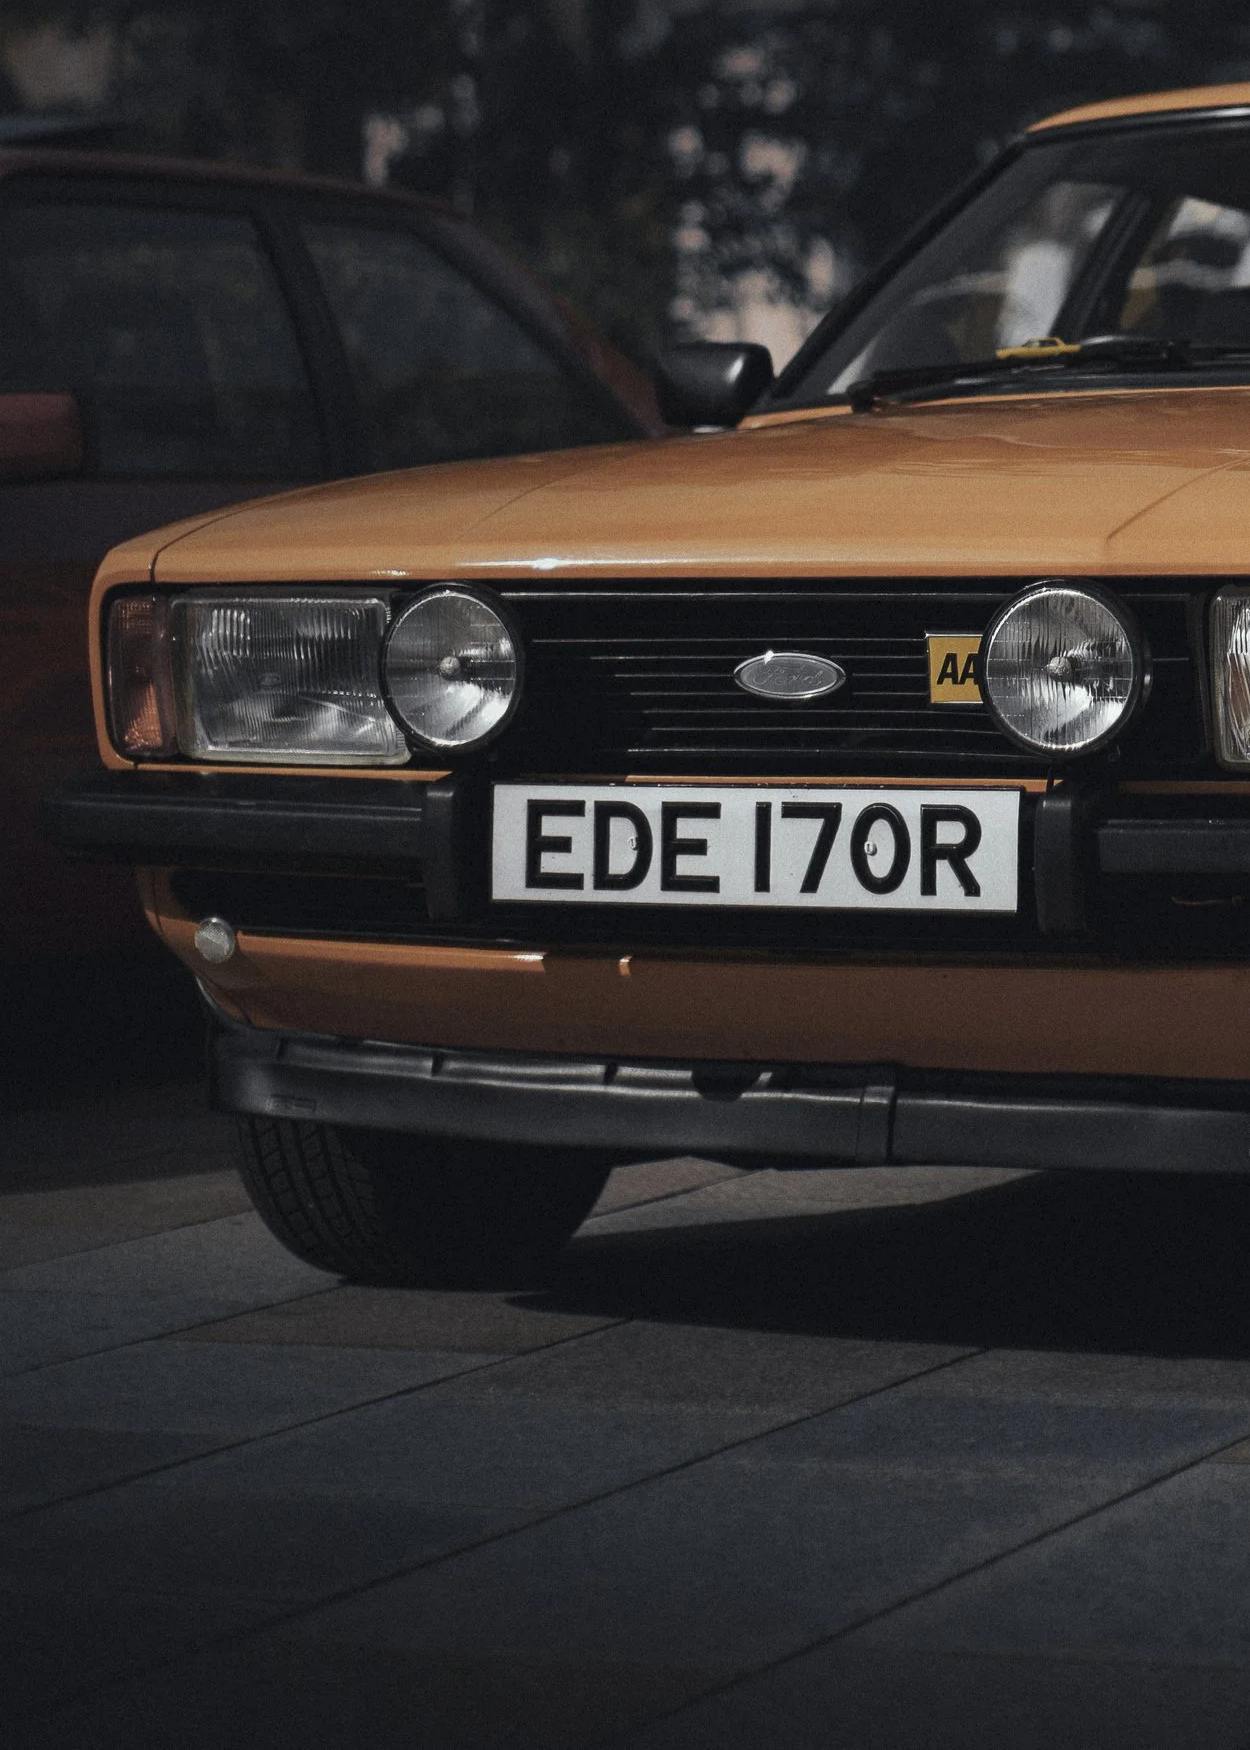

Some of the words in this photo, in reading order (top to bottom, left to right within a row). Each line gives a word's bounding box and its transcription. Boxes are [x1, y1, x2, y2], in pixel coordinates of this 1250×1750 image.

[751, 661, 825, 687] Ford
[936, 652, 979, 685] AA
[526, 799, 721, 894] EDE
[755, 802, 982, 897] 170R
